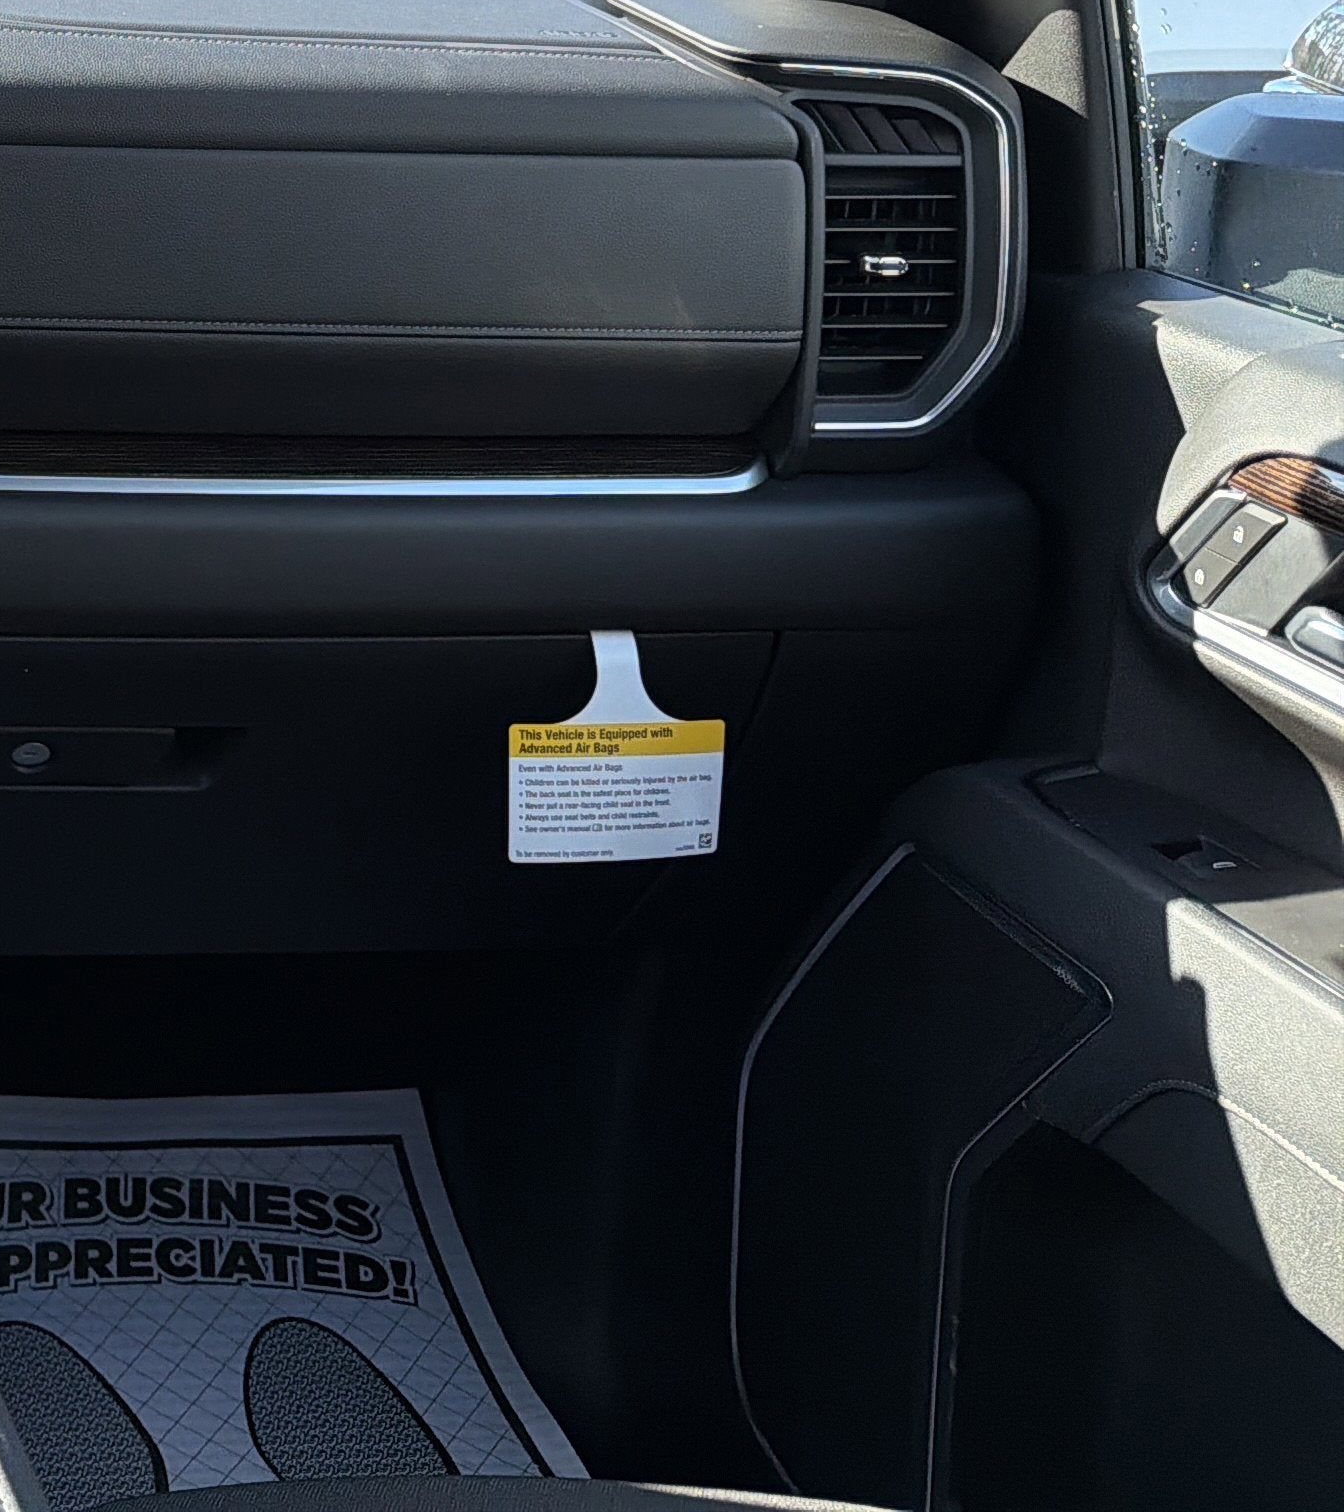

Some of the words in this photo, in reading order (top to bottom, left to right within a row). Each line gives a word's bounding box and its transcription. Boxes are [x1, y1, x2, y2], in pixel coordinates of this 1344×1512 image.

[518, 728, 542, 741] This
[545, 728, 585, 741] Vehicle
[587, 728, 597, 740] is
[600, 728, 648, 742] Equipped
[650, 726, 674, 739] with
[518, 742, 573, 754] Advanced
[575, 742, 592, 754] Air
[593, 742, 620, 756] Bags
[518, 764, 537, 773] Even
[538, 764, 555, 773] with
[556, 764, 592, 773] Advanced
[592, 764, 603, 772] Air
[604, 763, 623, 773] Bags
[64, 1173, 382, 1240] BUSINESS
